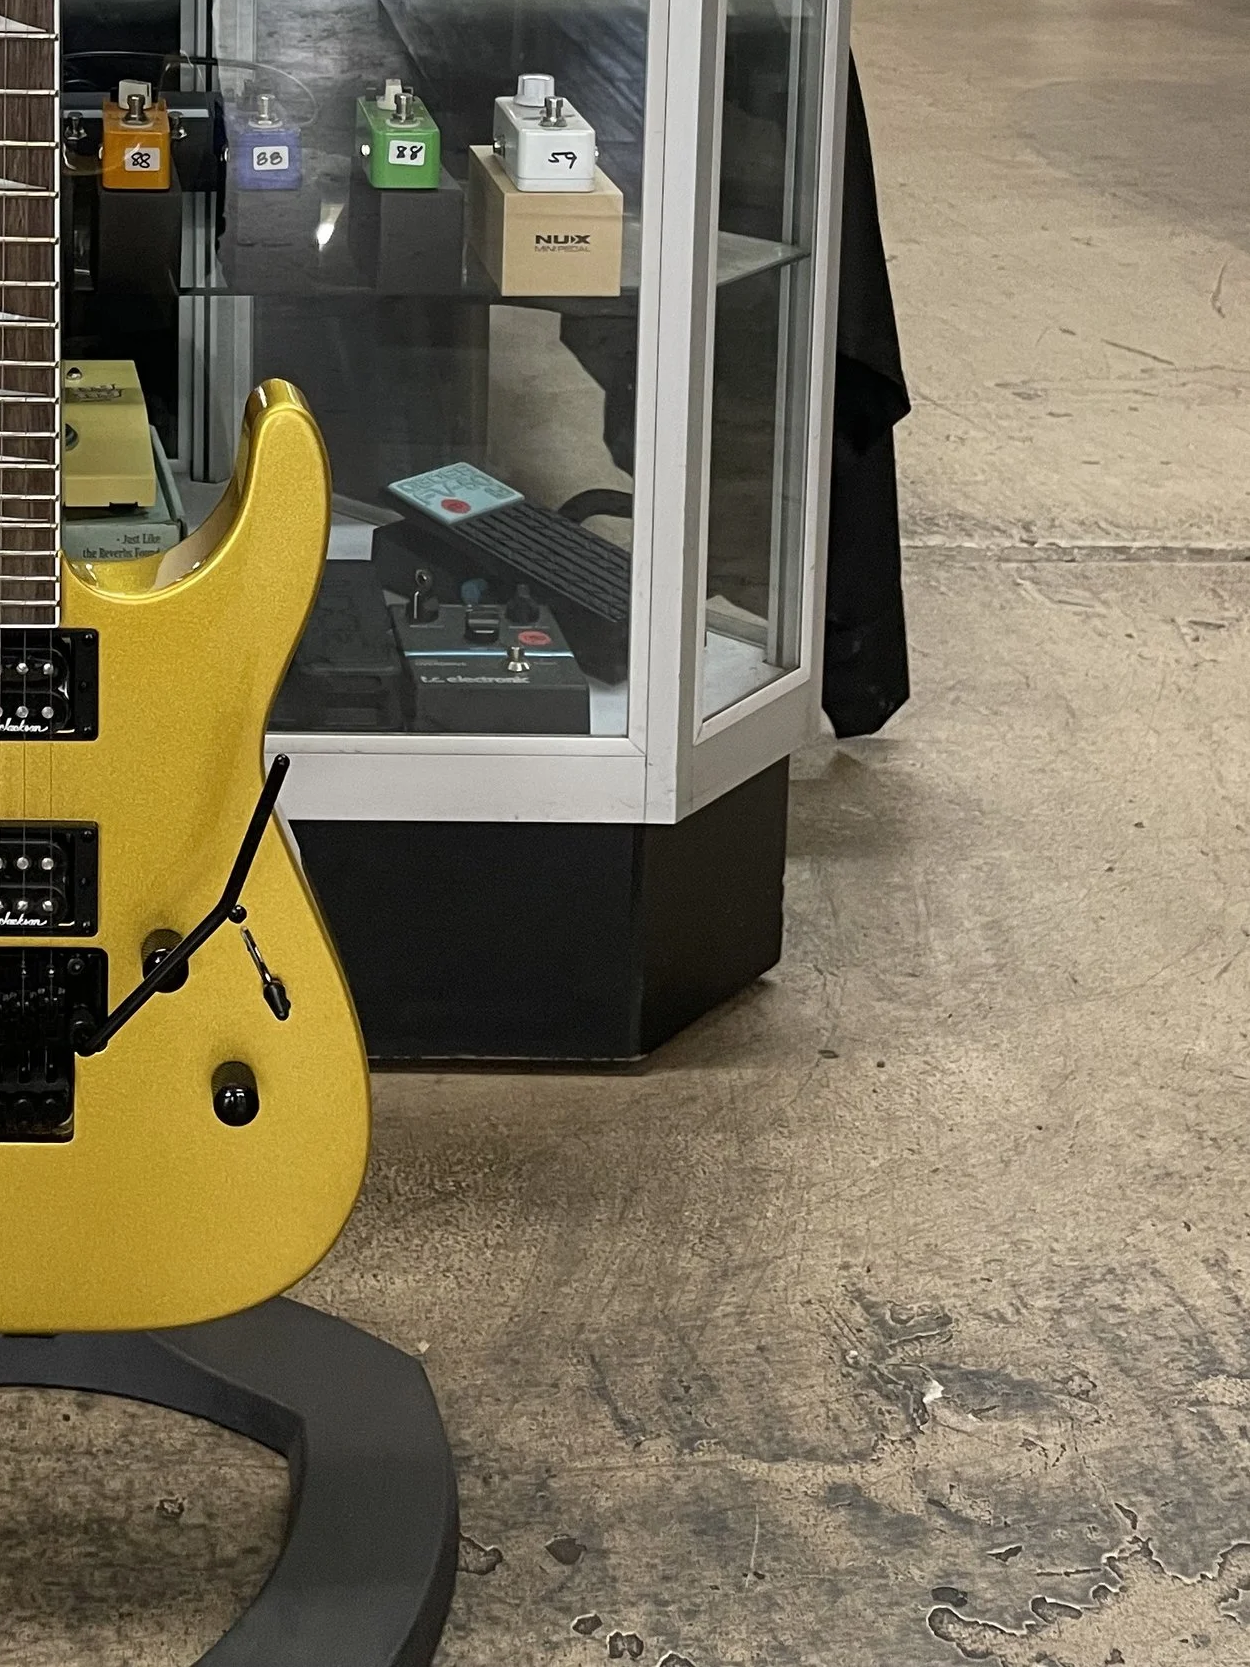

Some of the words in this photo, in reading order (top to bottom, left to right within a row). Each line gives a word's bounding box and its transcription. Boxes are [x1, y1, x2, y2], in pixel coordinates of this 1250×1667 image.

[394, 145, 423, 160] 88
[131, 152, 151, 168] 88
[548, 151, 578, 169] 59
[535, 234, 590, 244] NUX
[123, 534, 140, 544] Just
[142, 533, 161, 544] Like
[83, 548, 96, 559] the
[99, 547, 133, 559] Reverbs
[451, 675, 531, 684] electronic
